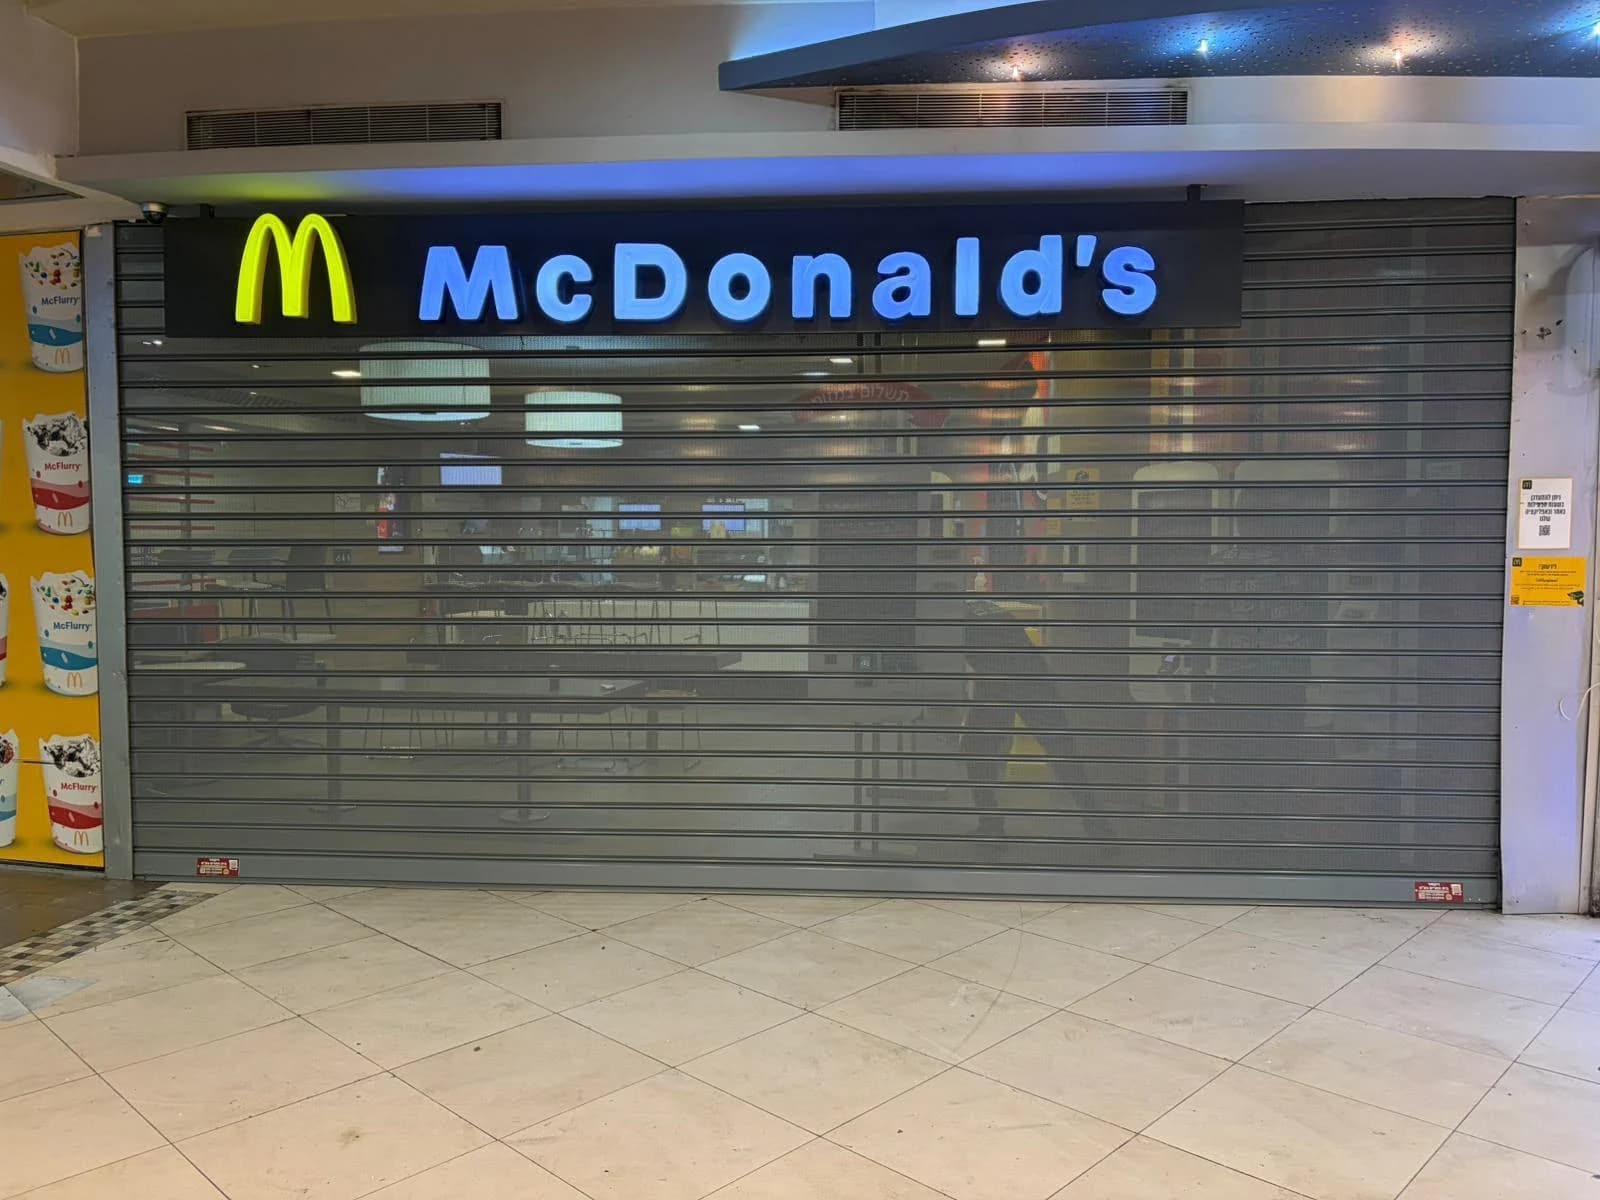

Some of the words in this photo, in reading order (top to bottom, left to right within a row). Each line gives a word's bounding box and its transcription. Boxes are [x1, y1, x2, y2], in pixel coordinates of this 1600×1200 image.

[418, 234, 1158, 322] McDonald's
[41, 296, 80, 306] McFlurry
[44, 462, 81, 472] McFlurry
[53, 621, 92, 632] McFlurry
[61, 782, 97, 793] McFlurry
